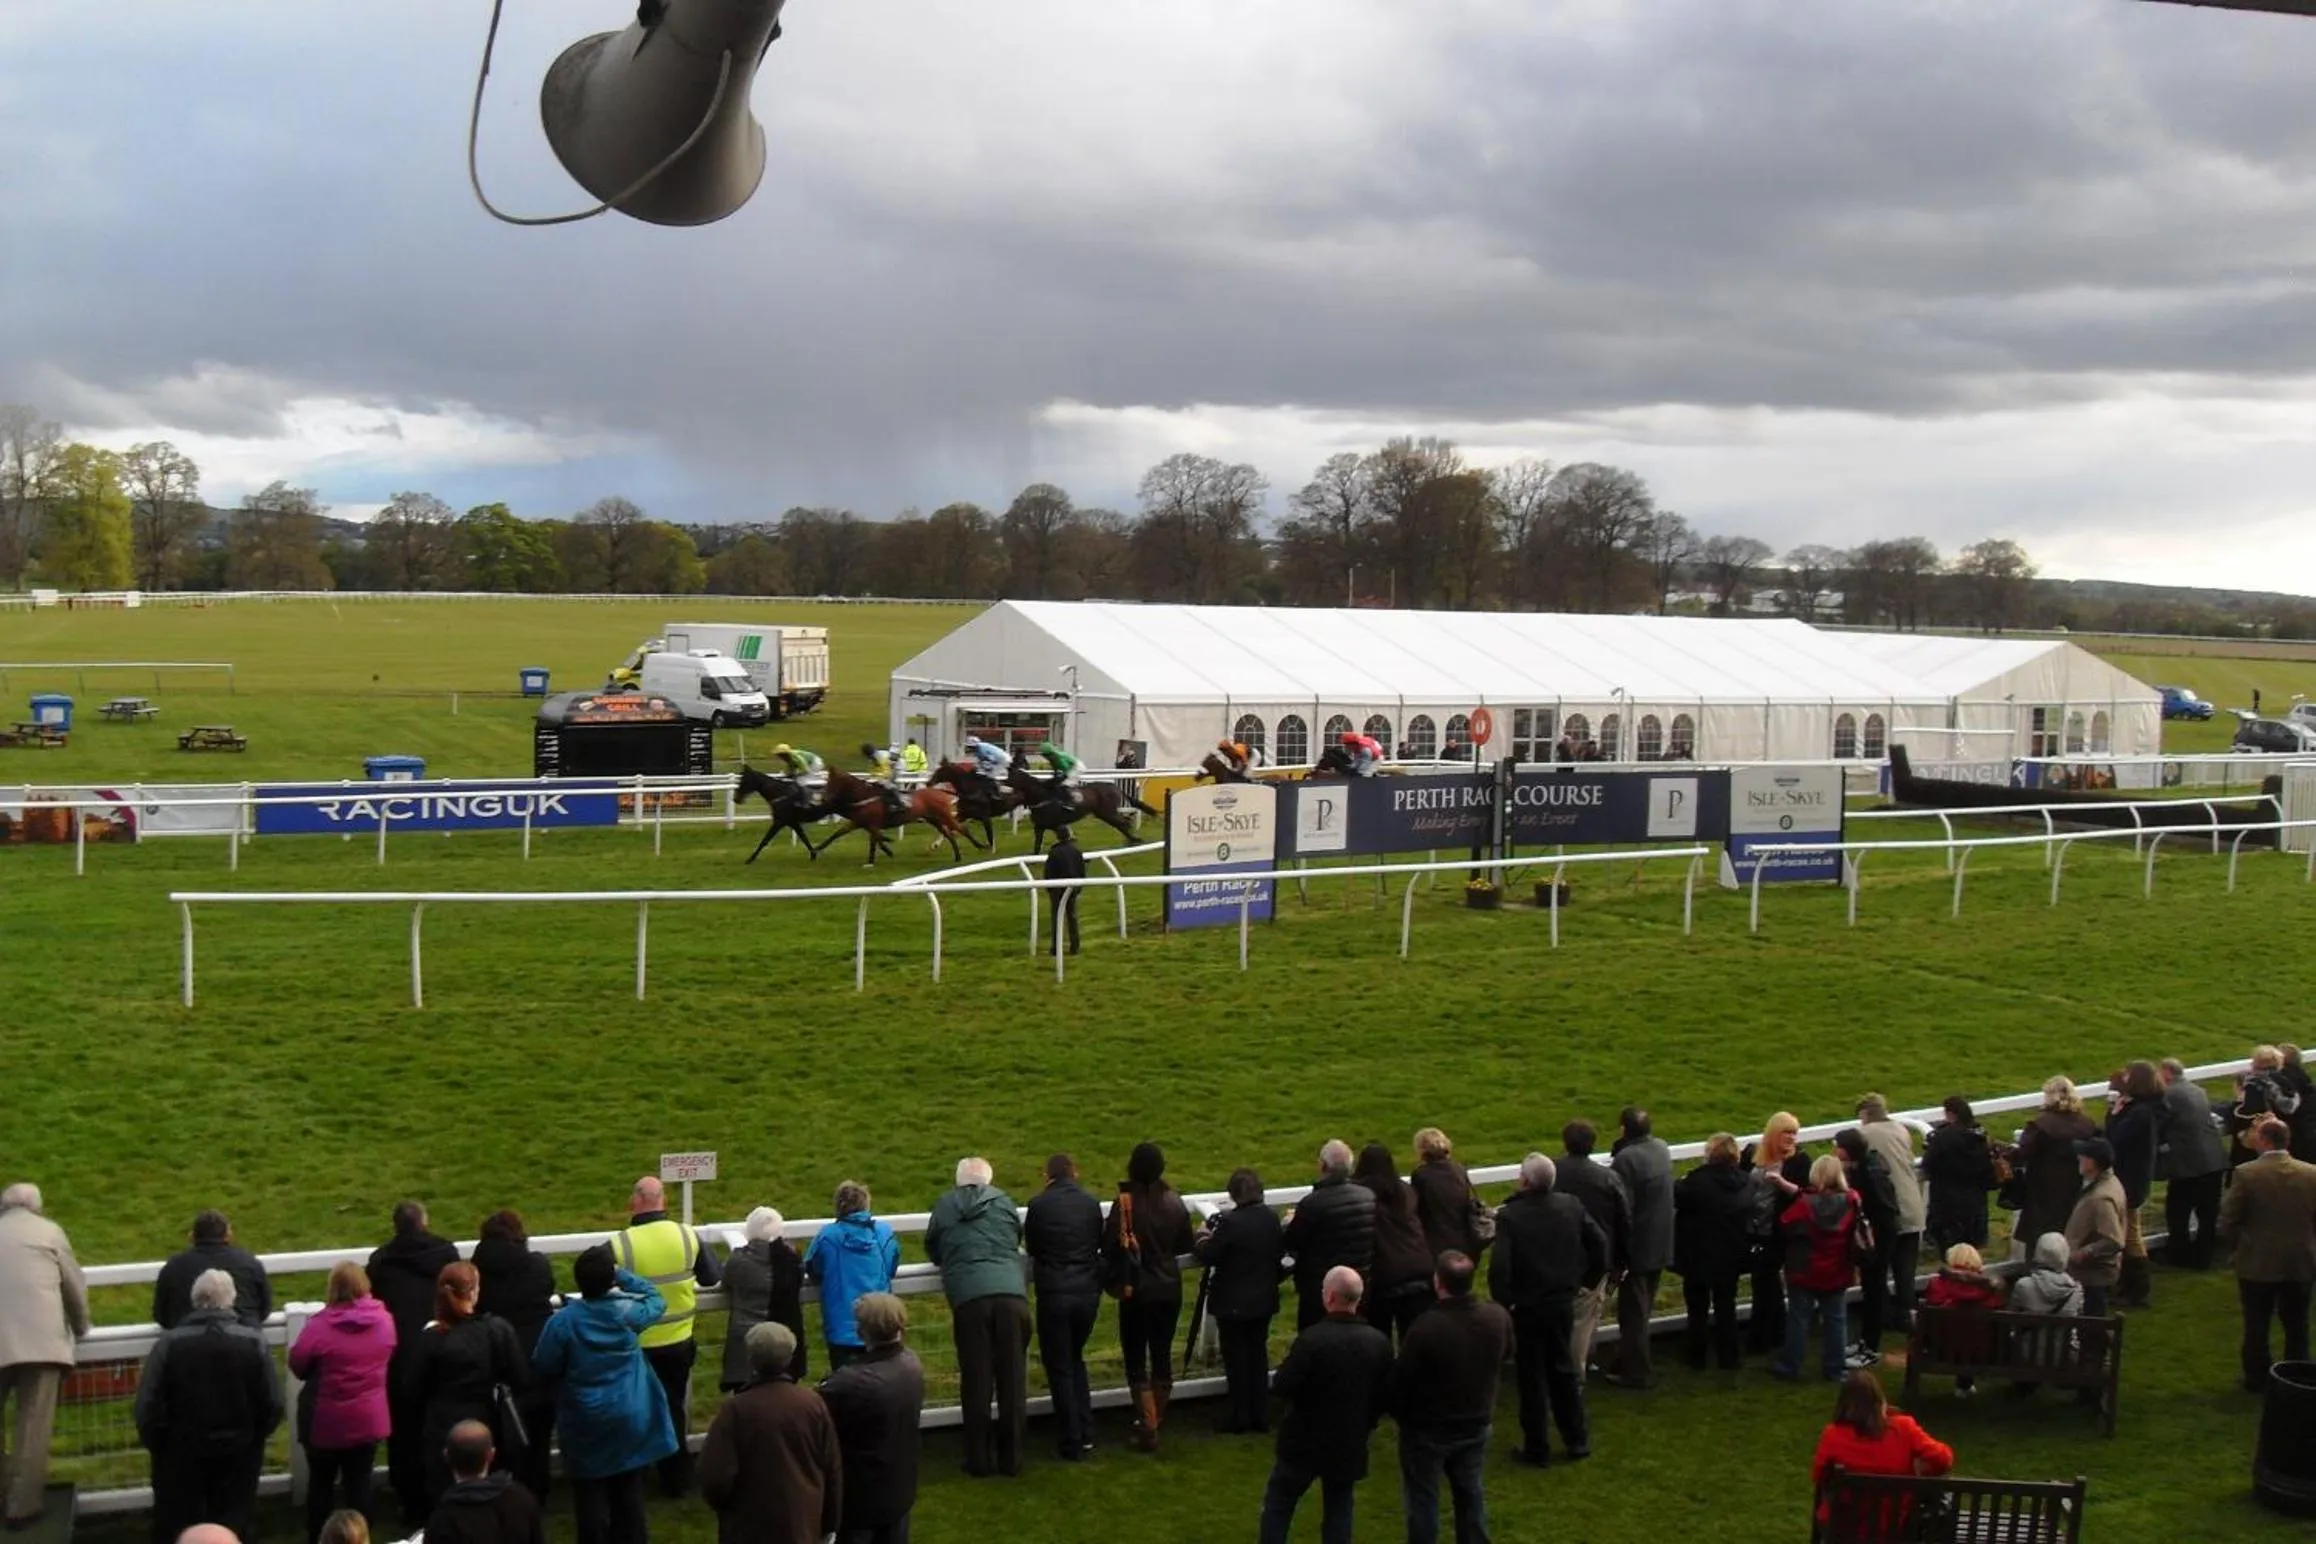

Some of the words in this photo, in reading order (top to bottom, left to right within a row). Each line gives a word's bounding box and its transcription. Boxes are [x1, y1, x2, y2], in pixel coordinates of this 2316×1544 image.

[1394, 787, 1456, 811] PERTH
[1463, 784, 1604, 807] RACCOURSE
[1746, 791, 1779, 806] ISLE
[1786, 790, 1826, 806] SKYE
[1187, 814, 1217, 833] ISLE
[1223, 812, 1261, 831] SKYE
